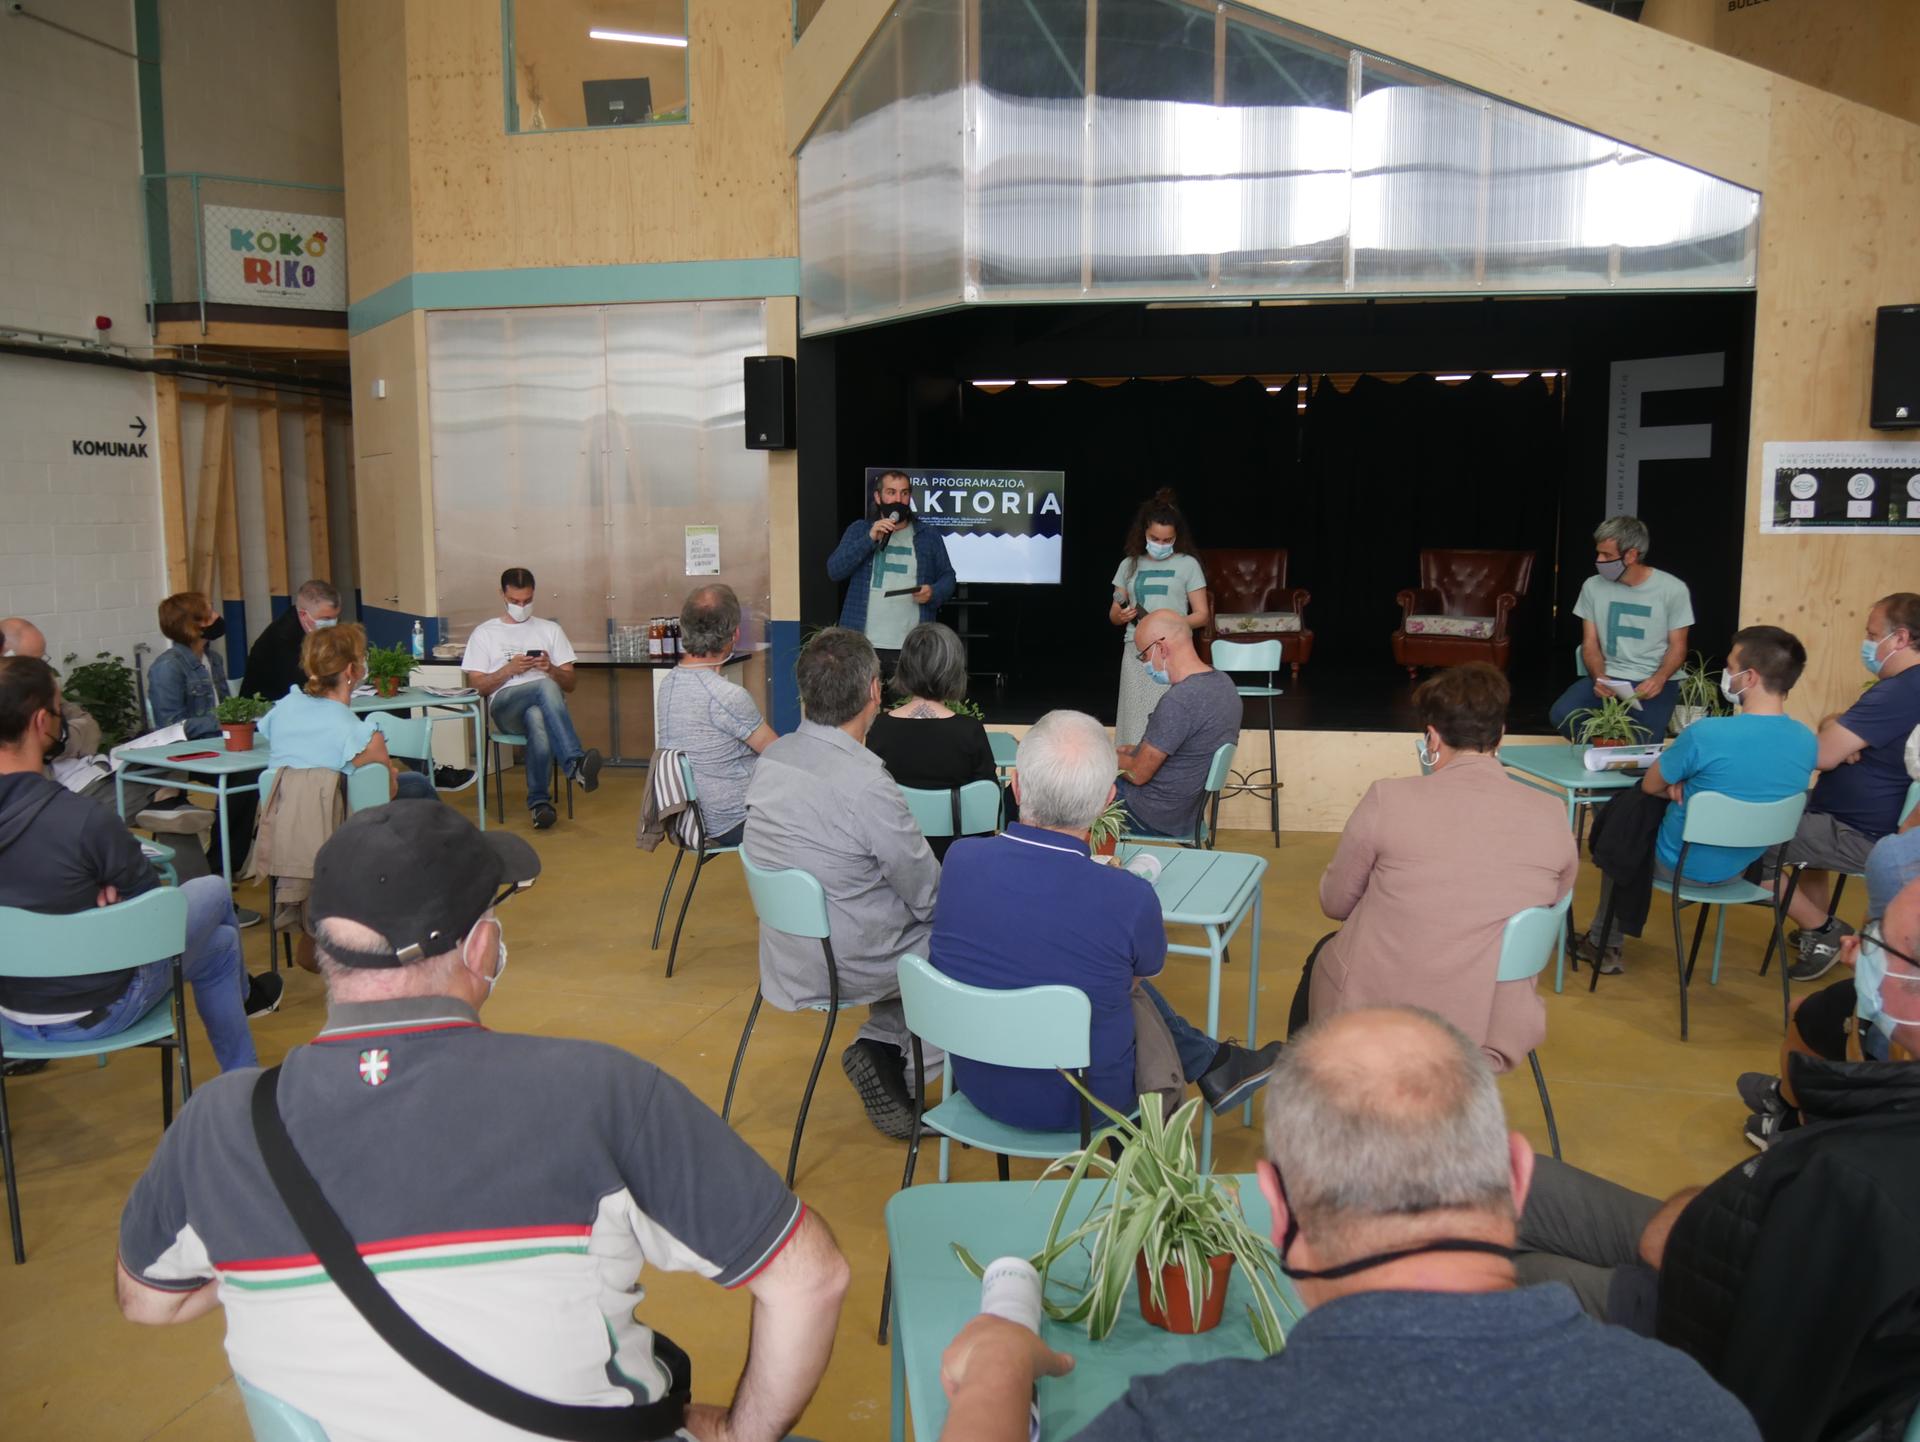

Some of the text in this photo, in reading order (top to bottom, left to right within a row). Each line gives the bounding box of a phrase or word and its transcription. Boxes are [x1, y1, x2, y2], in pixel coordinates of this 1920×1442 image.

[243, 257, 316, 289] RIKO
[72, 440, 148, 458] KOMUNAK
[932, 477, 1025, 488] PROGRAMAZIOA
[872, 545, 912, 589] F
[1606, 601, 1652, 657] F
